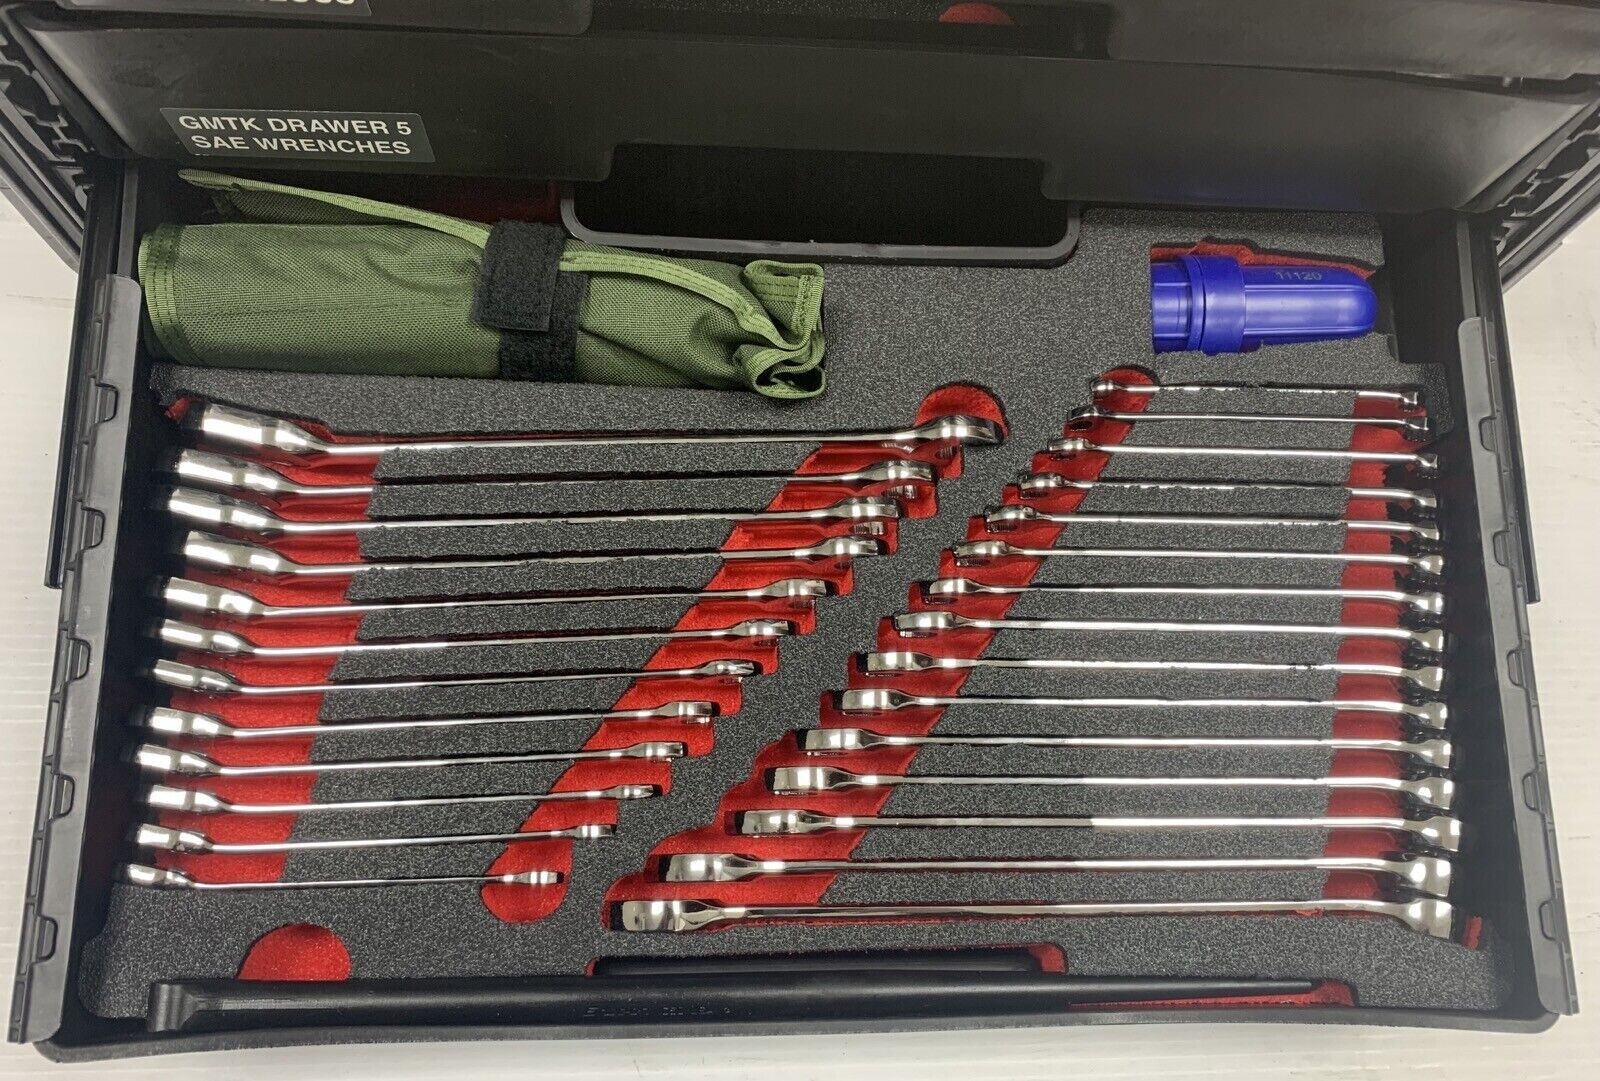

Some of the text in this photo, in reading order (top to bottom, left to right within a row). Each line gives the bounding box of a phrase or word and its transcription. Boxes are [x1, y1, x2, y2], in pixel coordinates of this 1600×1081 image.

[178, 115, 412, 135] GMTK DRAWER 5
[191, 135, 410, 154] SAE WRENCHES
